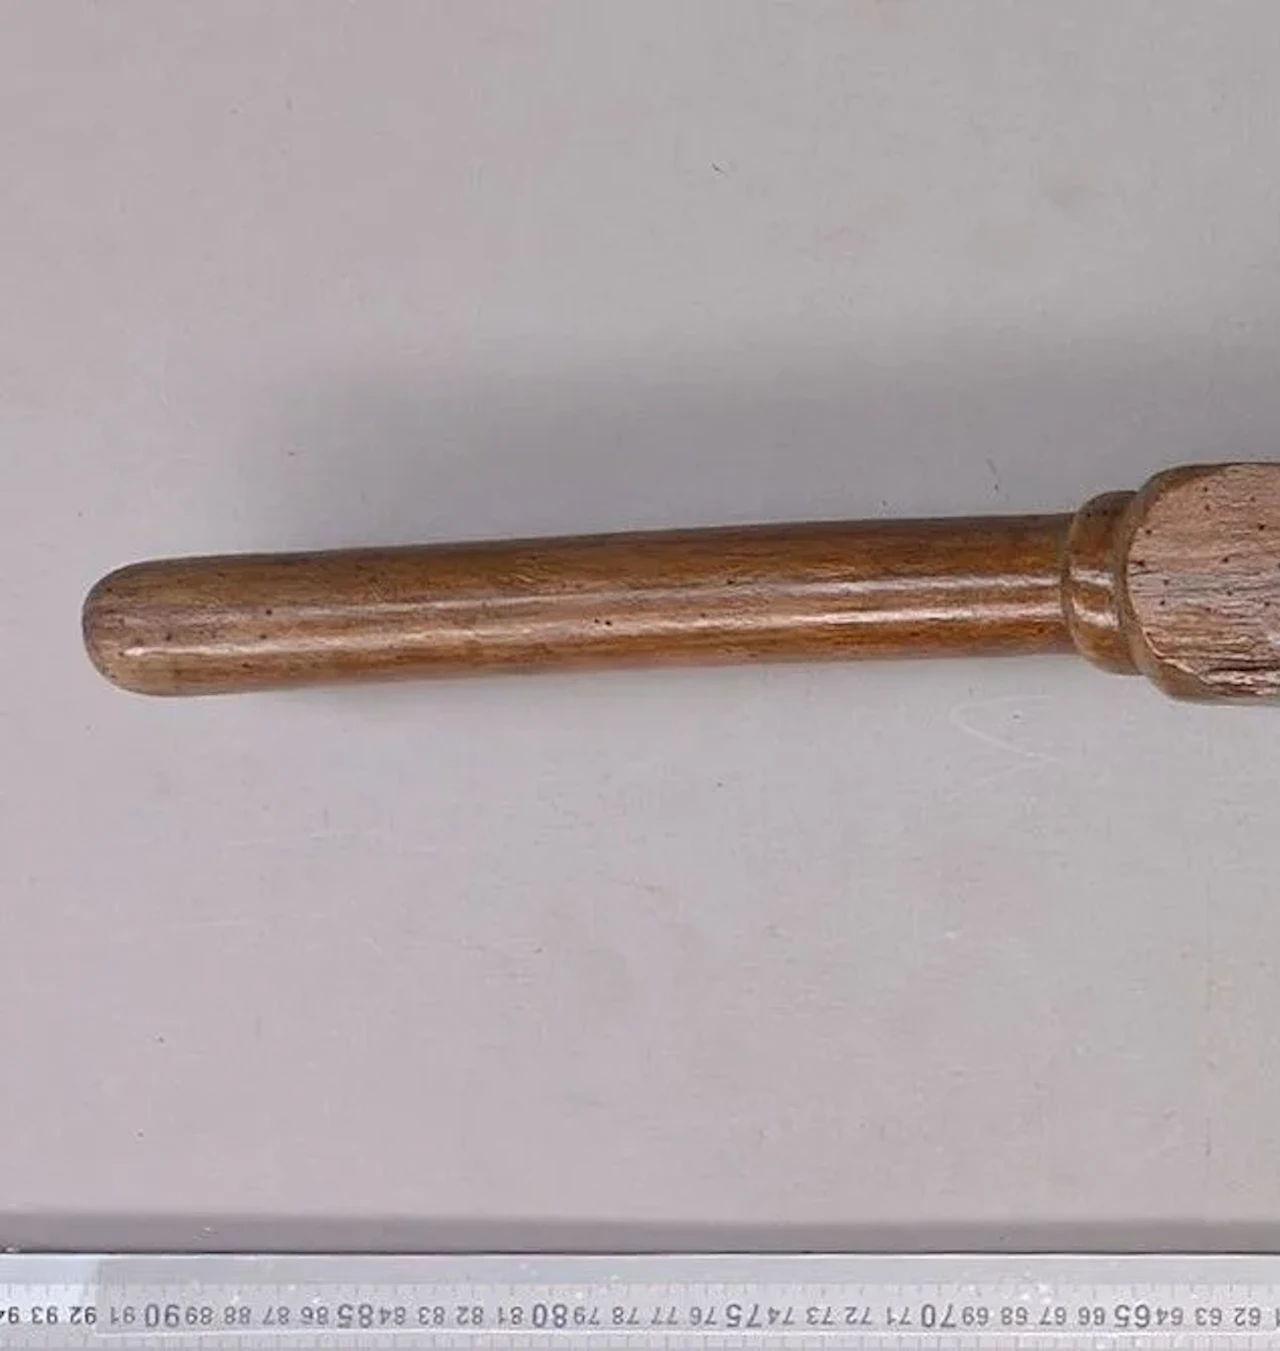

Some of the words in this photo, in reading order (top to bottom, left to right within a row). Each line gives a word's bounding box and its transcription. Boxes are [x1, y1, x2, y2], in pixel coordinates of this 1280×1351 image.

[32, 1307, 58, 1325] 93
[71, 1307, 97, 1325] 92
[111, 1306, 135, 1324] 91
[145, 1304, 179, 1327] 90
[186, 1307, 213, 1325] 89
[262, 1306, 290, 1325] 87
[337, 1304, 373, 1328] 85
[379, 1307, 406, 1326] 84
[419, 1307, 445, 1325] 83
[457, 1306, 484, 1325] 82
[498, 1307, 523, 1325] 81
[532, 1304, 567, 1328] 80
[573, 1307, 600, 1325] 79
[651, 1307, 678, 1325] 77
[690, 1307, 717, 1326] 76
[726, 1304, 762, 1328] 75
[768, 1307, 794, 1325] 74
[806, 1307, 835, 1325] 73
[845, 1307, 872, 1325] 72
[887, 1307, 912, 1326] 71
[921, 1304, 956, 1328] 70
[1039, 1307, 1066, 1326] 67
[1115, 1305, 1150, 1329] 65
[1156, 1307, 1183, 1326] 64
[1195, 1308, 1222, 1326] 63
[1234, 1307, 1261, 1327] 62
